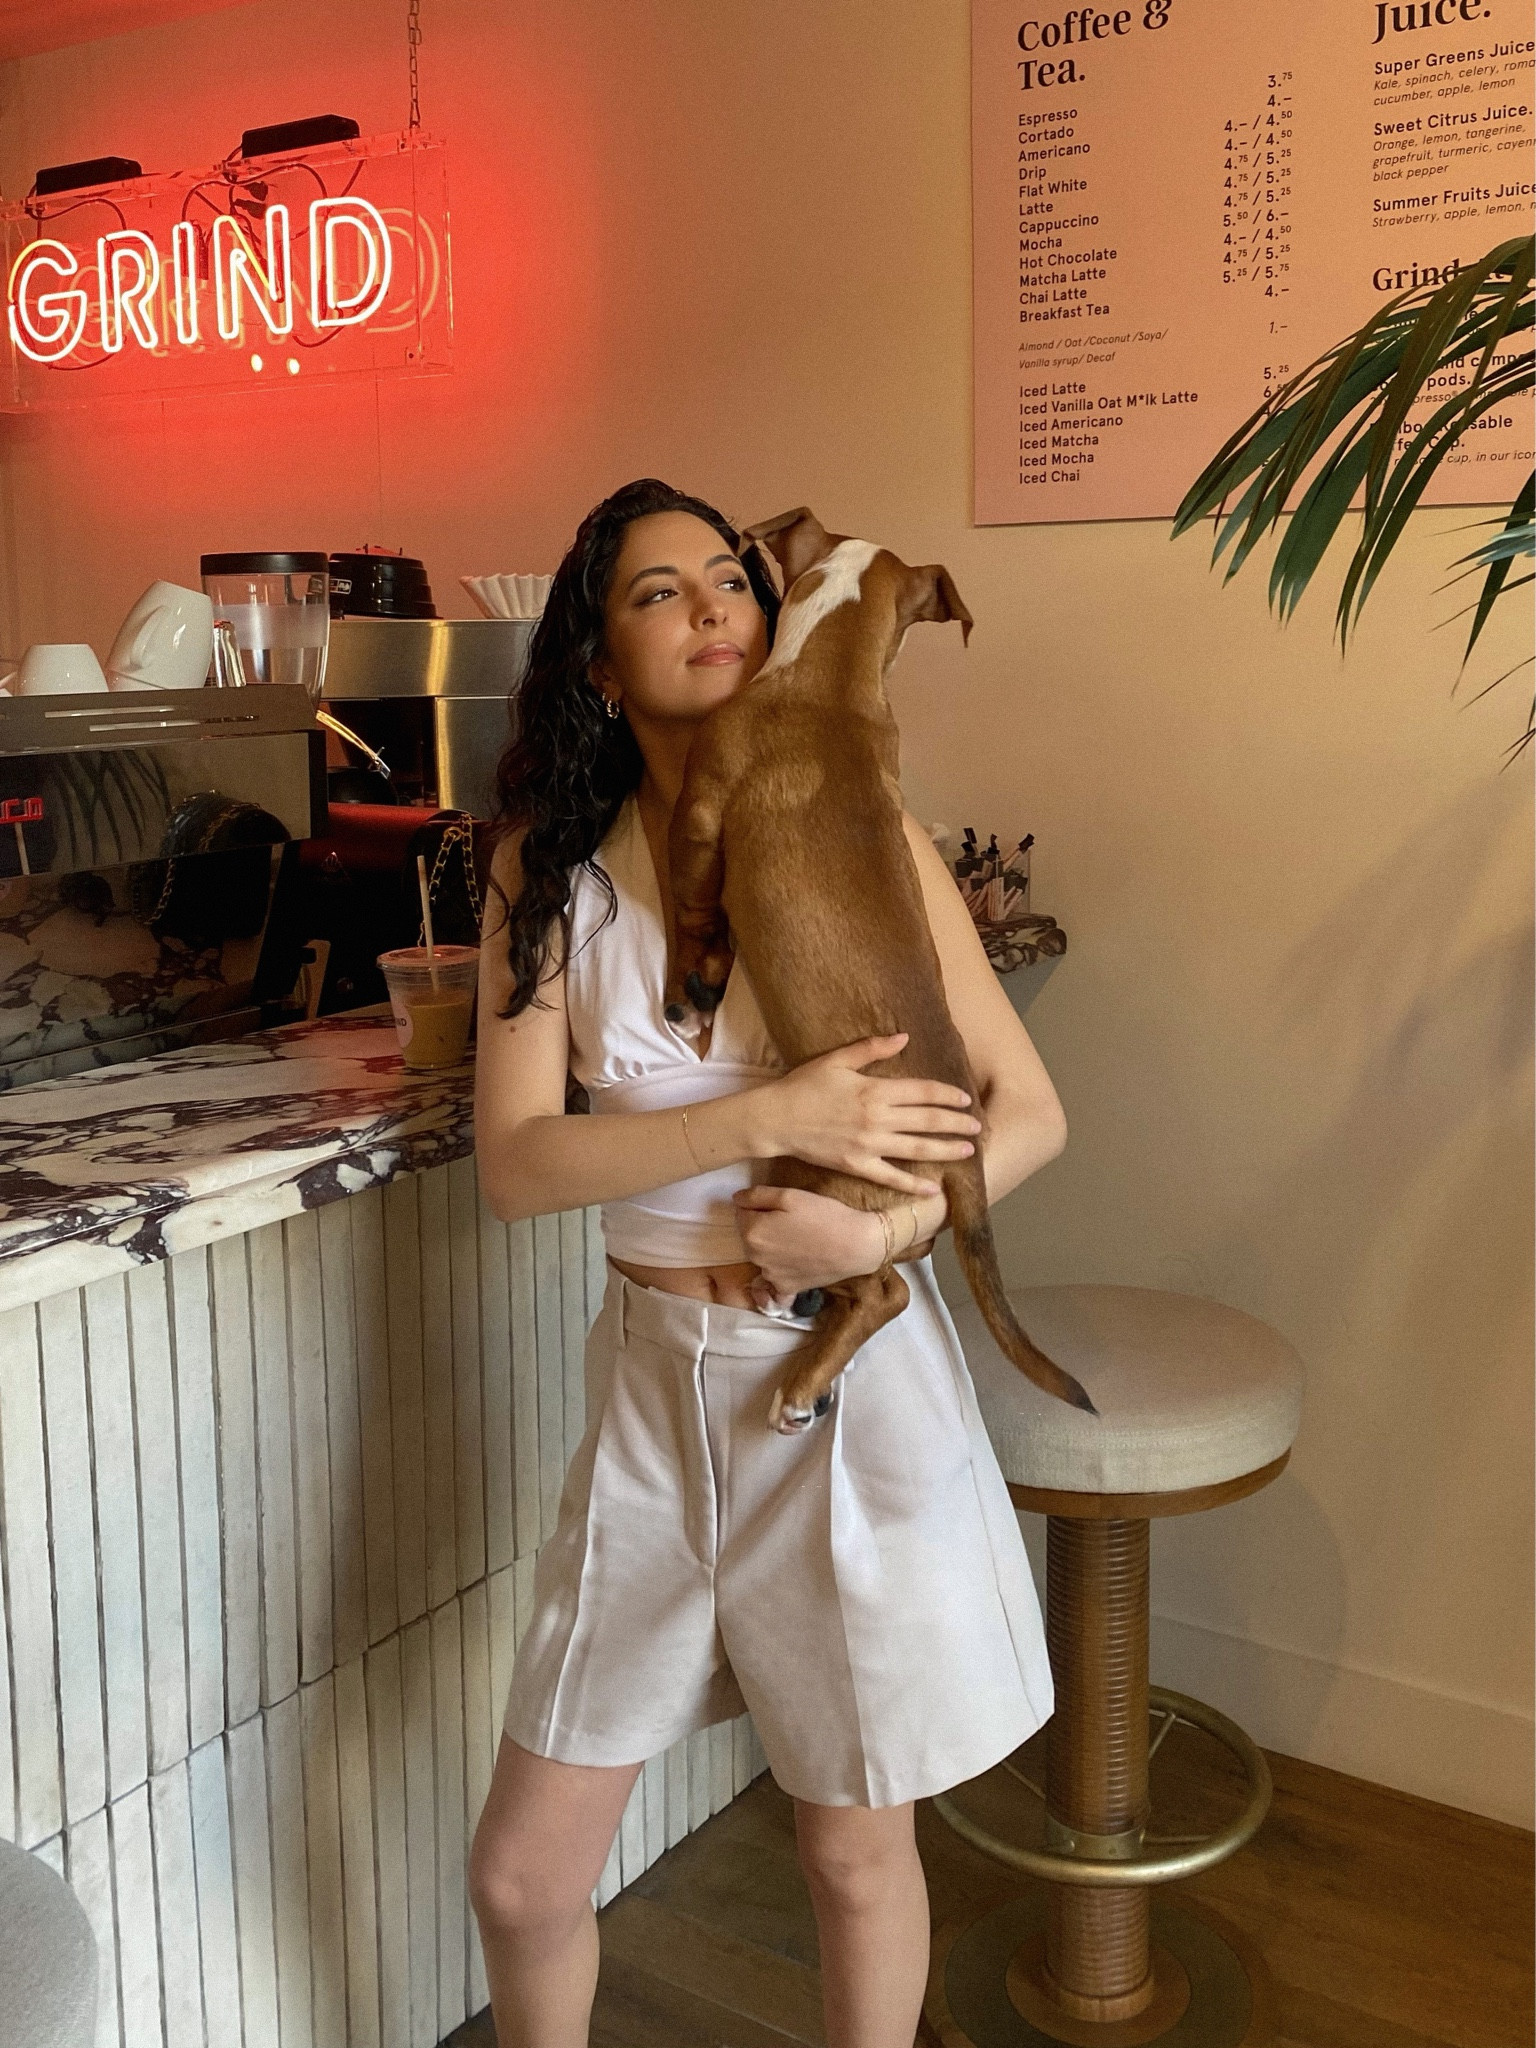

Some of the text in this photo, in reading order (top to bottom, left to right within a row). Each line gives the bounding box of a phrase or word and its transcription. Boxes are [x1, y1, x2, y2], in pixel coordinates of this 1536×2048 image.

[1018, 0, 1172, 51] Coffee &
[1371, 0, 1491, 44] Juice.
[1375, 59, 1422, 76] Super
[1426, 49, 1484, 67] Greens
[1017, 59, 1085, 90] Tea.
[1373, 78, 1401, 91] Kale,
[1405, 70, 1454, 88] spinach,
[1458, 65, 1499, 78] celery,
[1373, 78, 1515, 106] cucumber, apple, lemon
[1019, 109, 1077, 127] Espresso
[1374, 105, 1533, 136] Sweet Citrus Juice.
[1019, 126, 1074, 144] Cortado
[1373, 123, 1526, 151] Orange, lemon, tangerine,
[1018, 144, 1090, 162] Americano
[1372, 149, 1434, 169] grapefruit,
[1438, 142, 1492, 158] turmeric,
[1019, 166, 1046, 181] Drip
[1373, 165, 1450, 182] black pepper
[1019, 179, 1087, 198] Flat White
[1373, 195, 1438, 212] Summer
[1443, 187, 1490, 204] Fruits
[1019, 202, 1053, 216] Latte
[1372, 213, 1440, 227] Strawberry,
[1444, 206, 1480, 221] apple,
[1485, 203, 1525, 215] lemon,
[1019, 214, 1099, 235] Cappuccino
[1020, 236, 1062, 252] Mocha
[1020, 248, 1117, 269] Hot Chocolate
[8, 197, 392, 362] GRIND
[1020, 268, 1106, 287] Matcha Latte
[1373, 258, 1460, 291] Grind
[1020, 288, 1087, 304] Chai Latte
[1020, 304, 1109, 322] Breakfast Tea
[1018, 340, 1055, 352] Almond
[1019, 358, 1050, 369] Vanilla
[1086, 351, 1116, 363] Decaf
[1020, 382, 1086, 397] Iced Latte
[1427, 373, 1471, 390] pods.
[1020, 402, 1047, 415] Iced
[1051, 399, 1093, 412] Vanilla
[1098, 396, 1122, 409] Oat
[1162, 391, 1198, 404] Latte
[1020, 416, 1123, 432] Iced Americano
[1020, 434, 1099, 449] Iced Matcha
[1428, 435, 1465, 451] Cp.
[1020, 452, 1094, 467] Iced Mocha
[1446, 453, 1472, 465] cup,
[1476, 451, 1487, 462] in
[1490, 450, 1510, 462] our
[1020, 469, 1080, 484] Iced Chai
